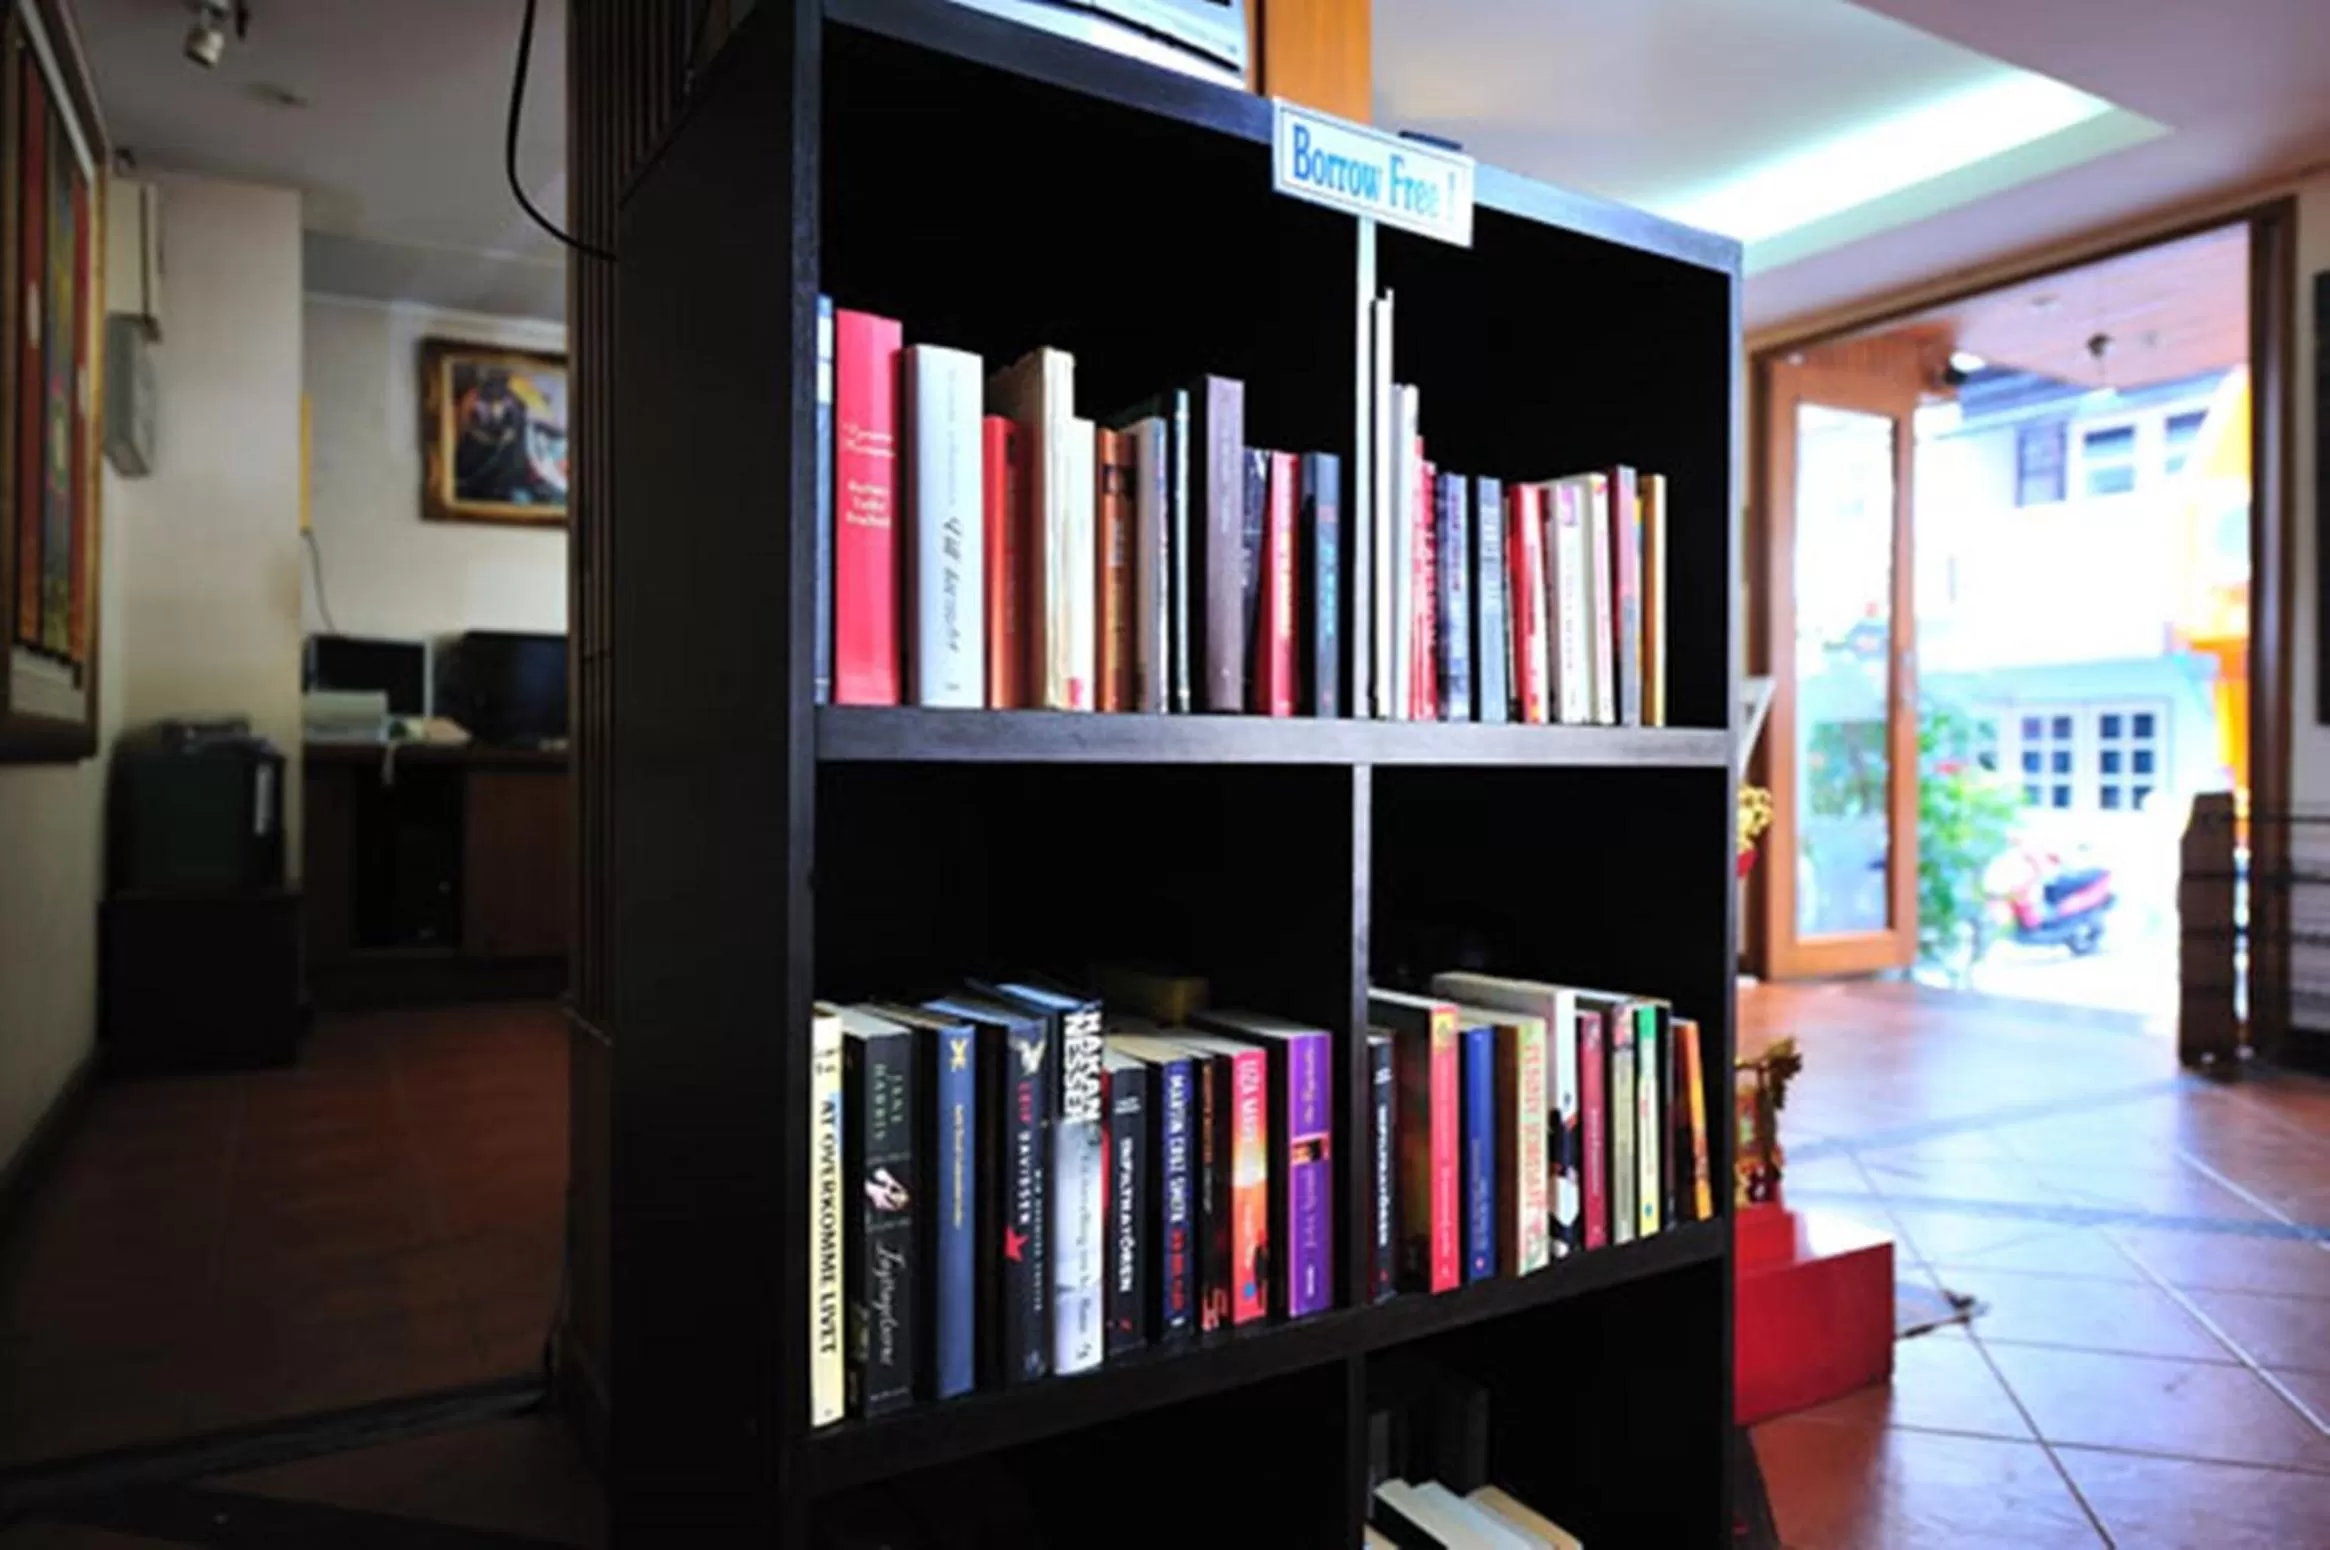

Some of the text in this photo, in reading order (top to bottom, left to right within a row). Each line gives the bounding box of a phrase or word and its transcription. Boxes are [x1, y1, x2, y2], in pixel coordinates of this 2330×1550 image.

[1293, 124, 1382, 201] Borrow
[1389, 153, 1440, 218] Free
[872, 1063, 888, 1141] HARRIS
[1168, 1073, 1187, 1134] MARTIN
[817, 1100, 838, 1354] AT OVERKOMME LIVET
[1118, 1136, 1135, 1292] INFILTRATÖREN
